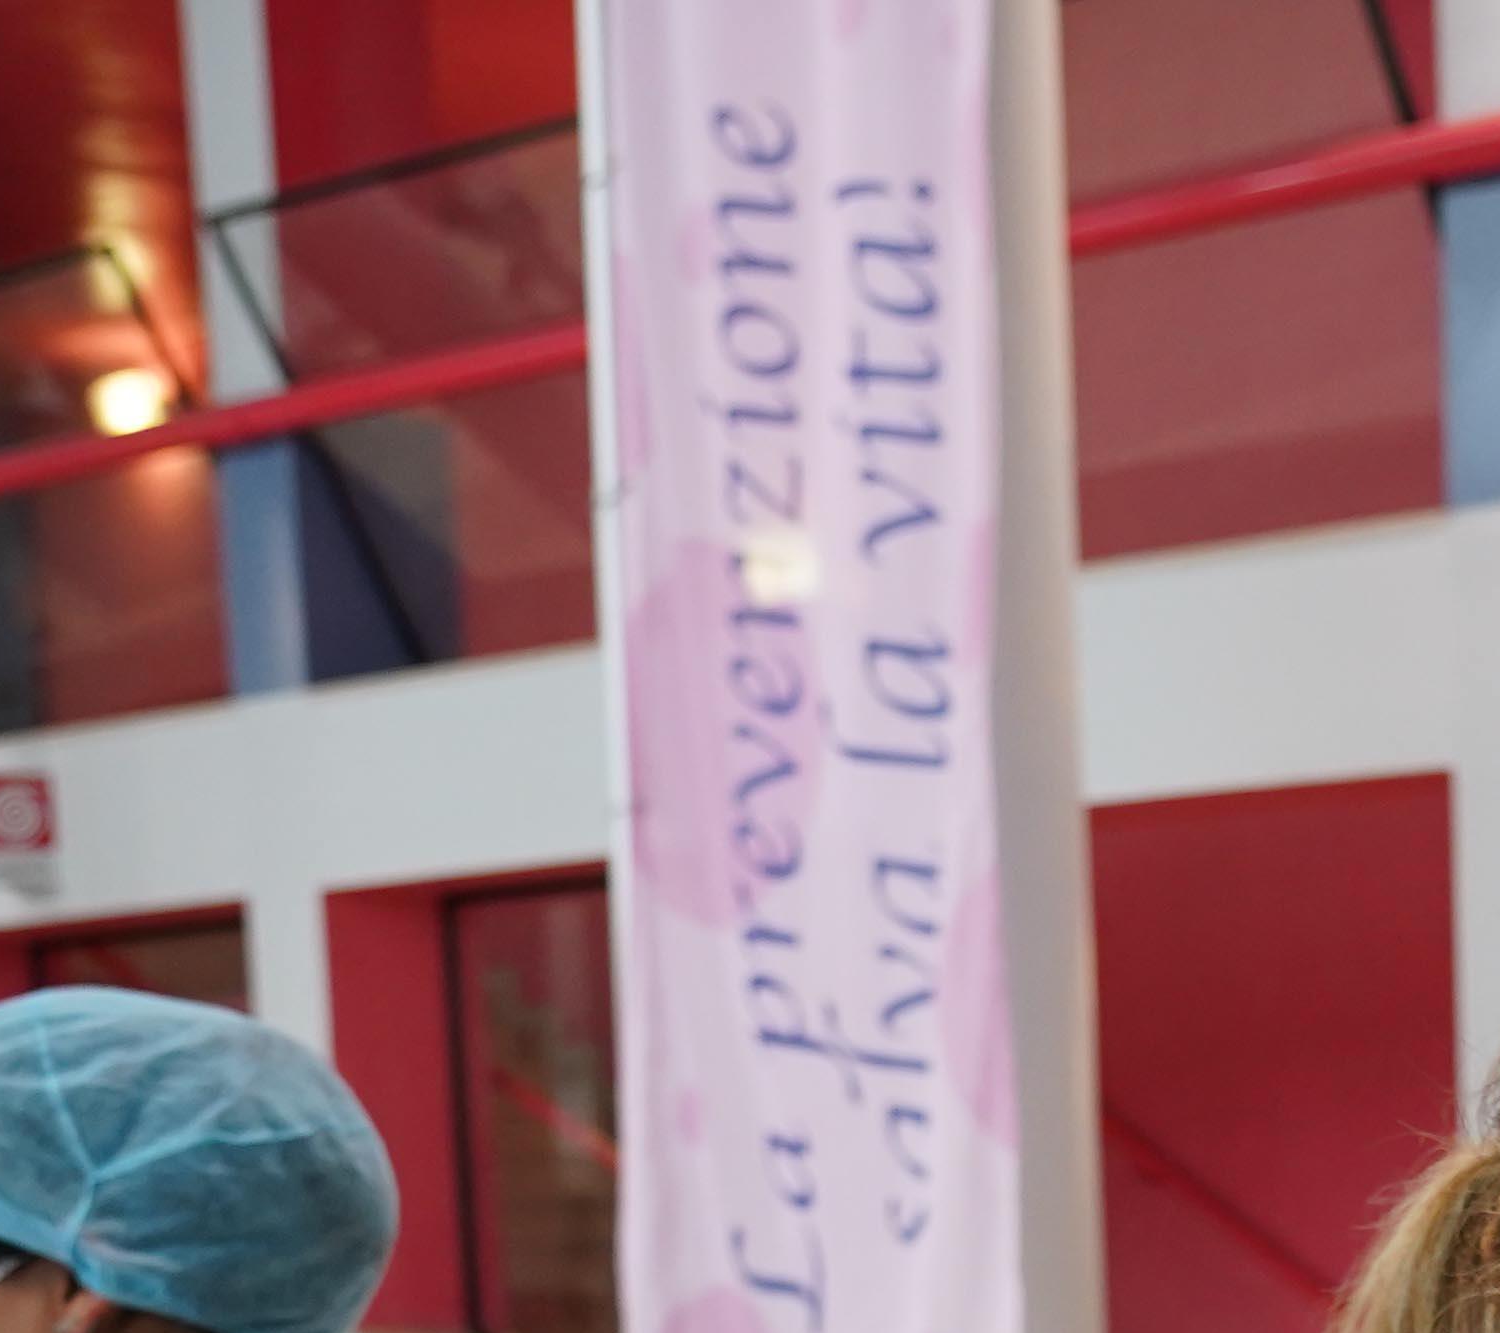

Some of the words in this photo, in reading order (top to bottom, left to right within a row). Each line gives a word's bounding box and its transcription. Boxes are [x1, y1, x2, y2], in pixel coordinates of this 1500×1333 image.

[833, 179, 942, 562] vita!
[697, 102, 845, 1080] prevenzione
[825, 632, 952, 766] la
